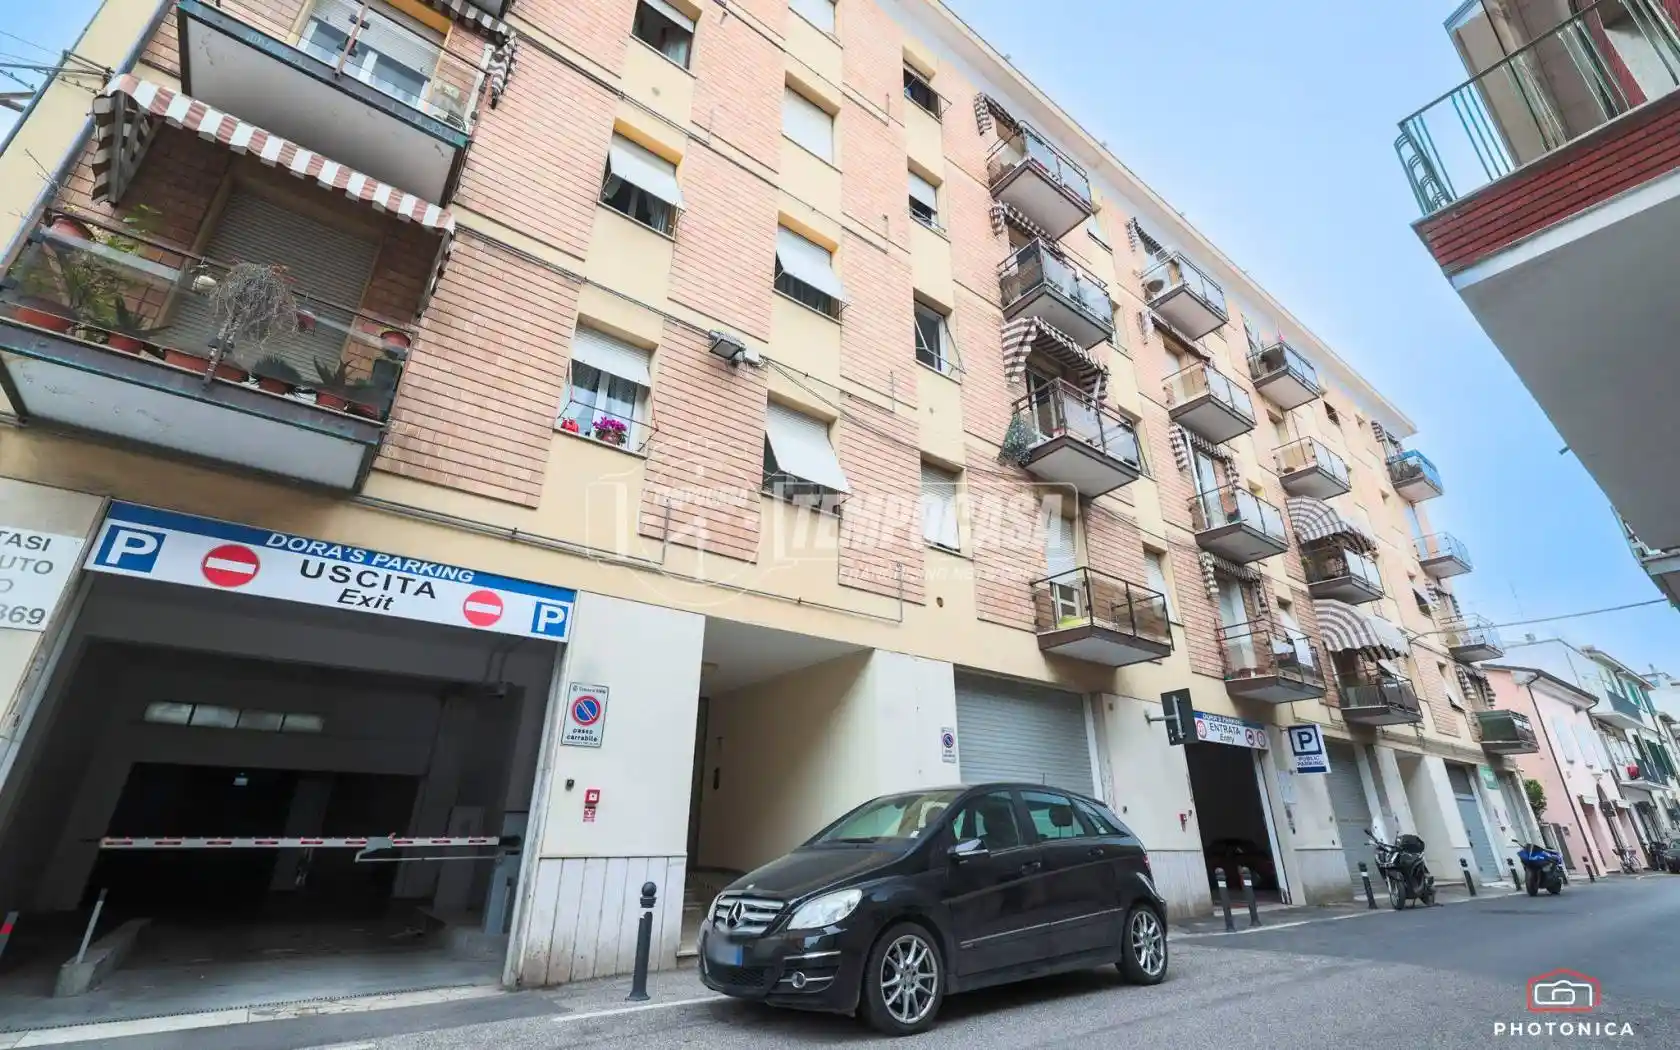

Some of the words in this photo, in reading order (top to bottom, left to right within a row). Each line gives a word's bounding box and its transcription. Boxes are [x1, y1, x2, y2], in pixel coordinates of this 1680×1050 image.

[105, 529, 158, 565] P
[266, 533, 368, 562] DORA'S
[371, 552, 476, 583] PARKING
[300, 559, 436, 599] USCITA
[336, 588, 395, 611] Exit
[536, 604, 565, 633] P
[566, 734, 598, 742] carrabile
[1209, 722, 1241, 736] ENTRATA
[1297, 731, 1313, 750] P
